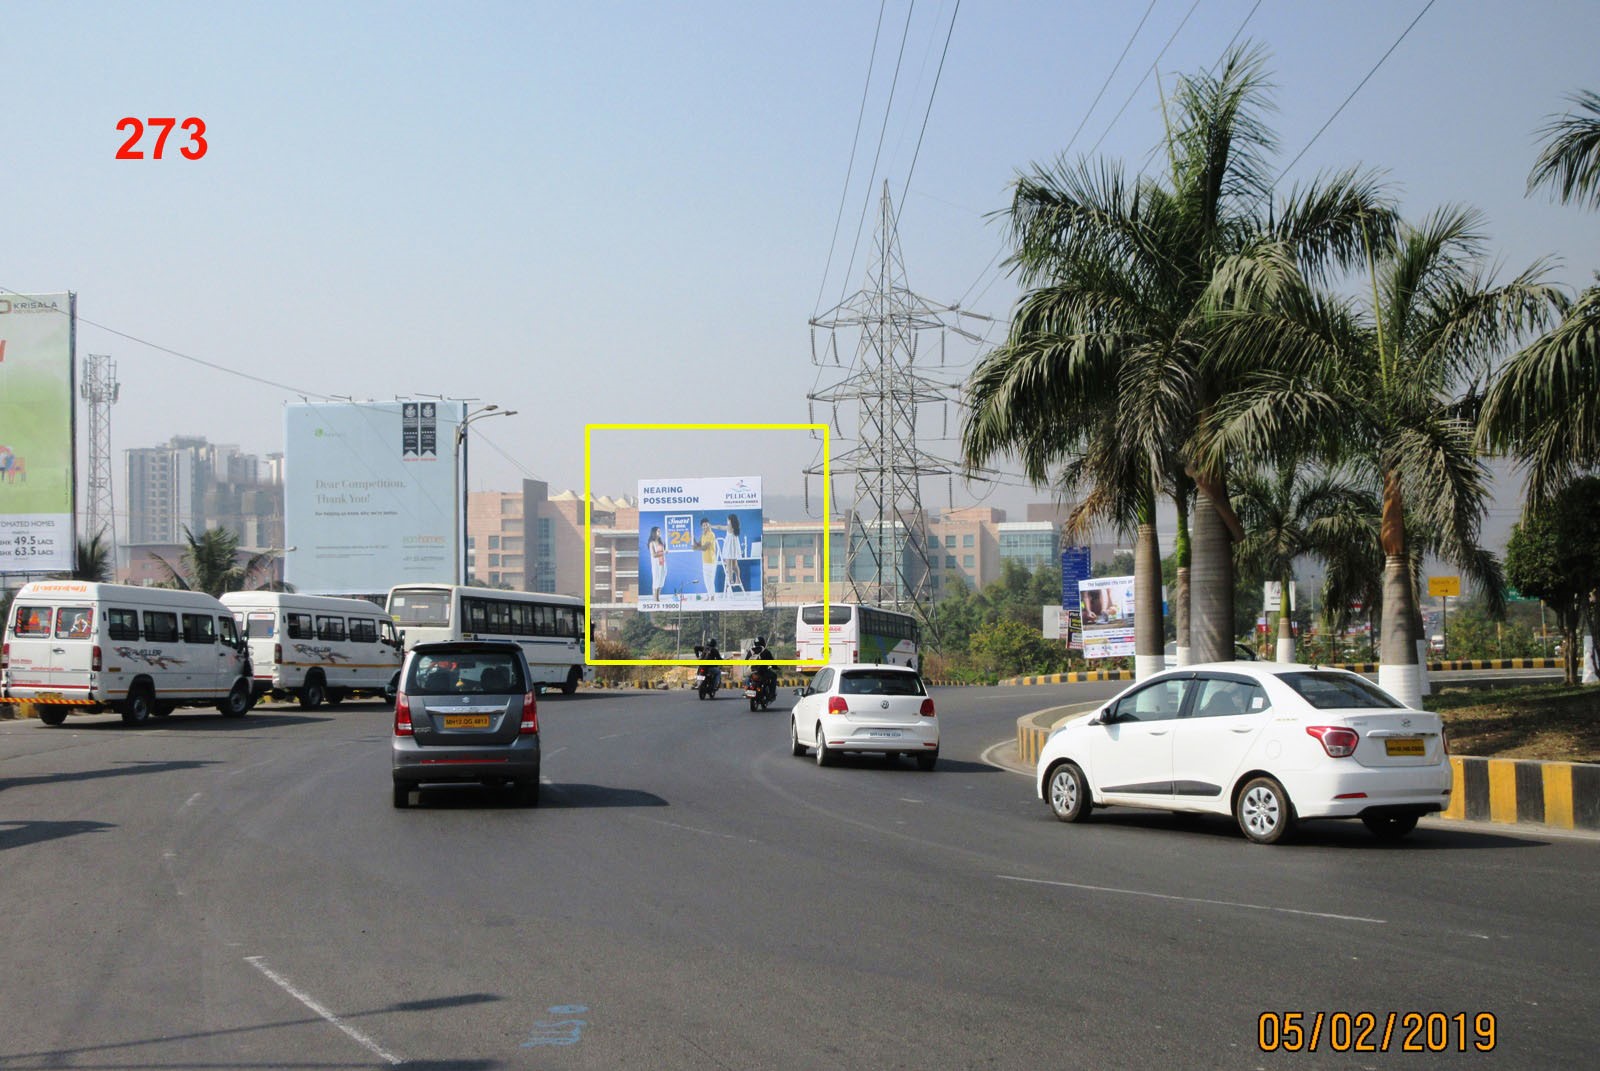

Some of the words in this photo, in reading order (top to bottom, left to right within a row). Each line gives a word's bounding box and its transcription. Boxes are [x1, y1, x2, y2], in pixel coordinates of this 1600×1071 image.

[315, 479, 338, 489] Dear
[643, 486, 683, 494] NEARING
[316, 494, 346, 504] Thank
[643, 496, 699, 504] POSSESSION
[14, 535, 36, 545] 49.5
[14, 546, 36, 556] 63.5
